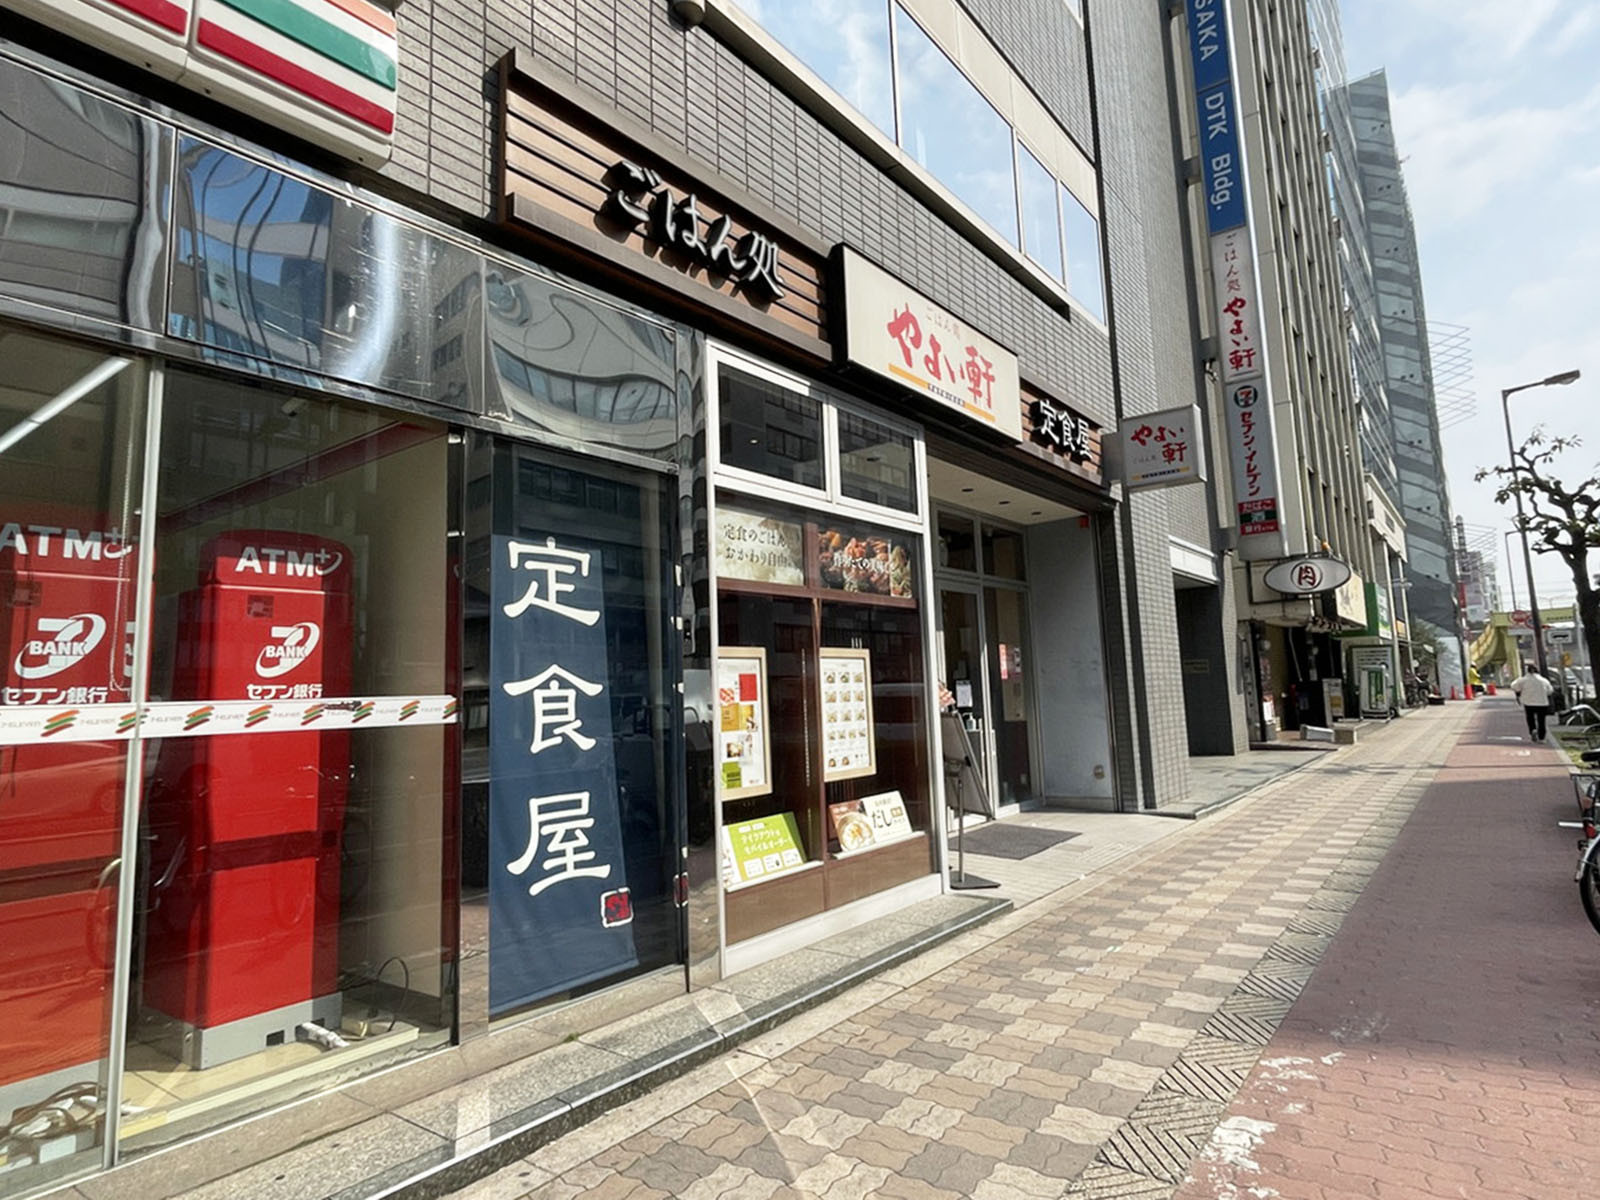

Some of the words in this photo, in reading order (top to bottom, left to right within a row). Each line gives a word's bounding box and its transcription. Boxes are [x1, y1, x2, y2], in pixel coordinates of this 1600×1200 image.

[1205, 91, 1229, 140] DTK
[1211, 152, 1234, 211] Bldg.
[606, 159, 785, 299] ごはん処
[1224, 232, 1242, 293] ごはん処
[886, 302, 997, 409] やよい軒
[1223, 296, 1257, 372] やよい軒
[1040, 399, 1093, 460] 定食屋
[29, 641, 87, 656] BANK
[265, 645, 308, 659] BANK
[1, 686, 109, 705] セブン銀行
[246, 684, 323, 700] セブン銀行
[503, 537, 611, 897] 定食屋
